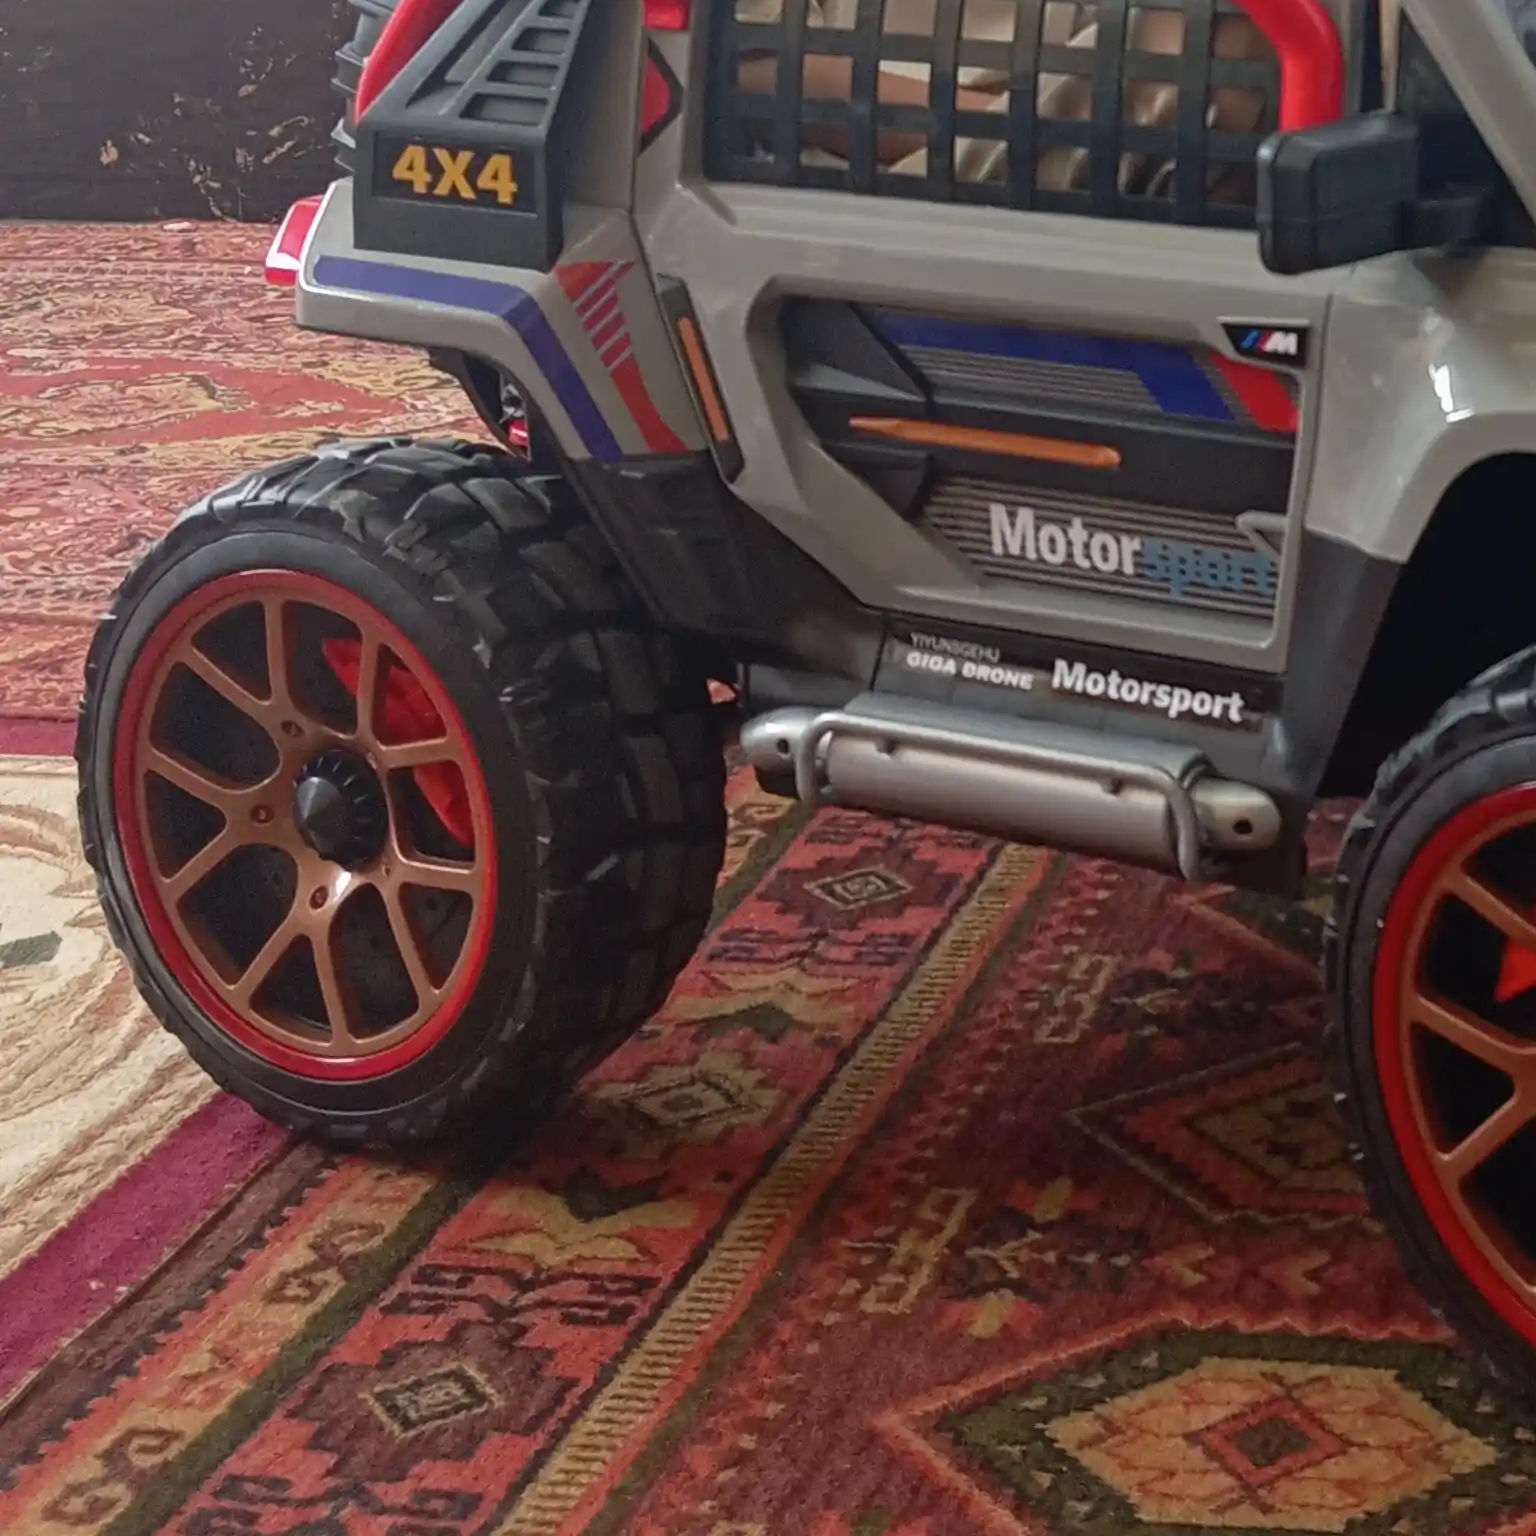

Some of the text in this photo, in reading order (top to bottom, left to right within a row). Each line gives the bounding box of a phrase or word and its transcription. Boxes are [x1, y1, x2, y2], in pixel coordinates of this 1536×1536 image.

[392, 144, 518, 204] 4X4
[962, 661, 1034, 690] DRONE
[1052, 658, 1245, 723] Motorsport
